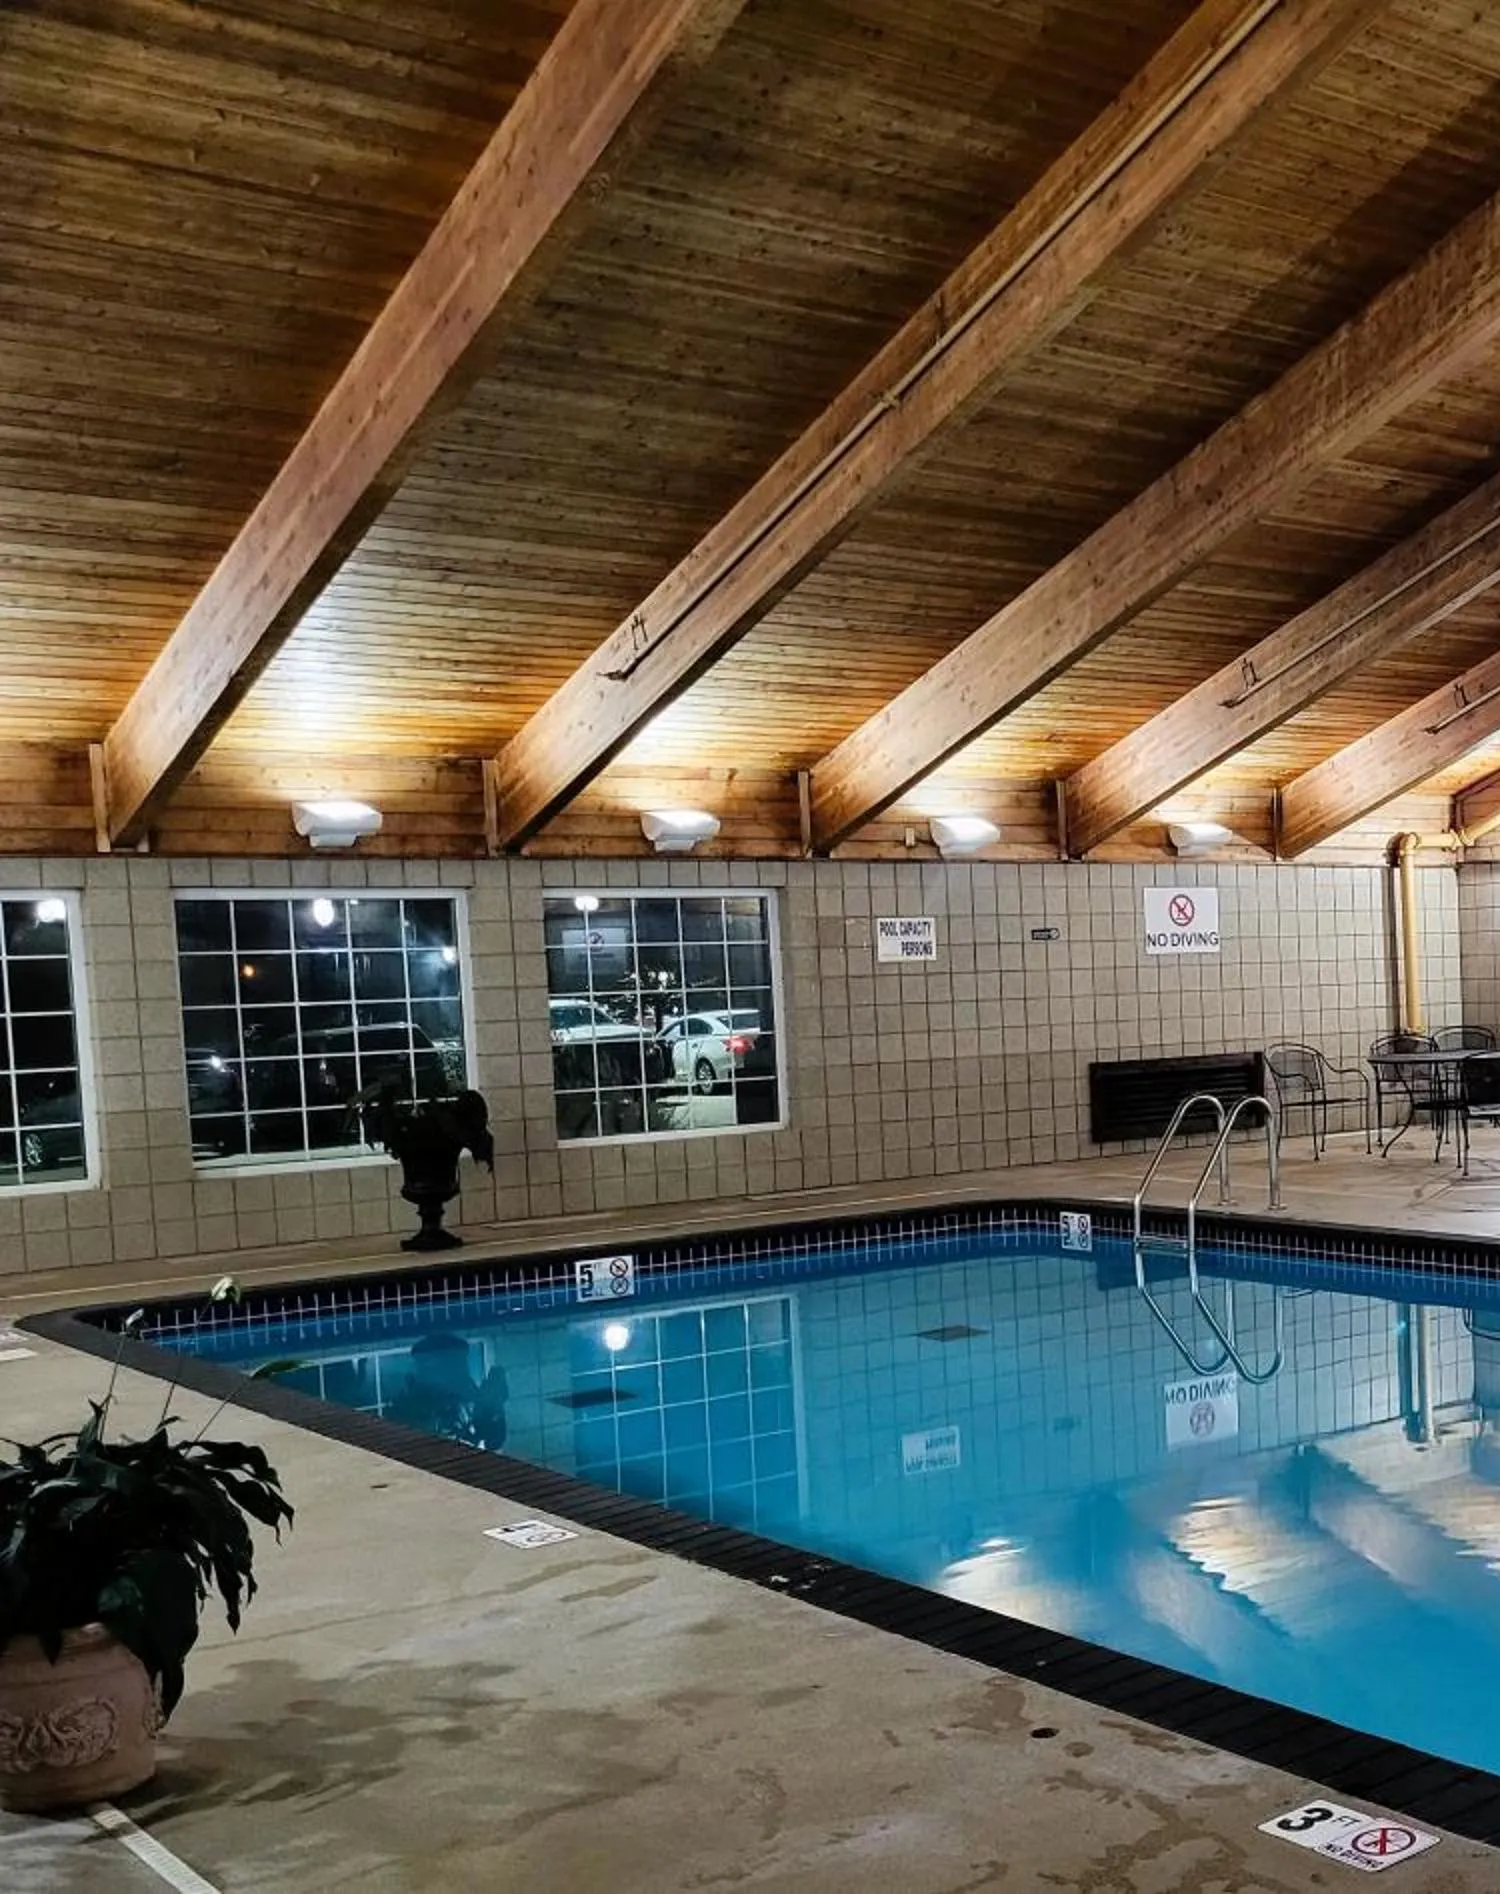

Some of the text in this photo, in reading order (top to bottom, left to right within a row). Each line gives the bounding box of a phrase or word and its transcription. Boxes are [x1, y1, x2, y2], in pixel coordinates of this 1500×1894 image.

[880, 921, 931, 936] POOL CAPACITY
[1147, 931, 1219, 948] NO DIVING
[901, 941, 933, 956] PERSONS
[580, 1264, 594, 1284] 5
[1277, 1807, 1360, 1831] 3 FT
